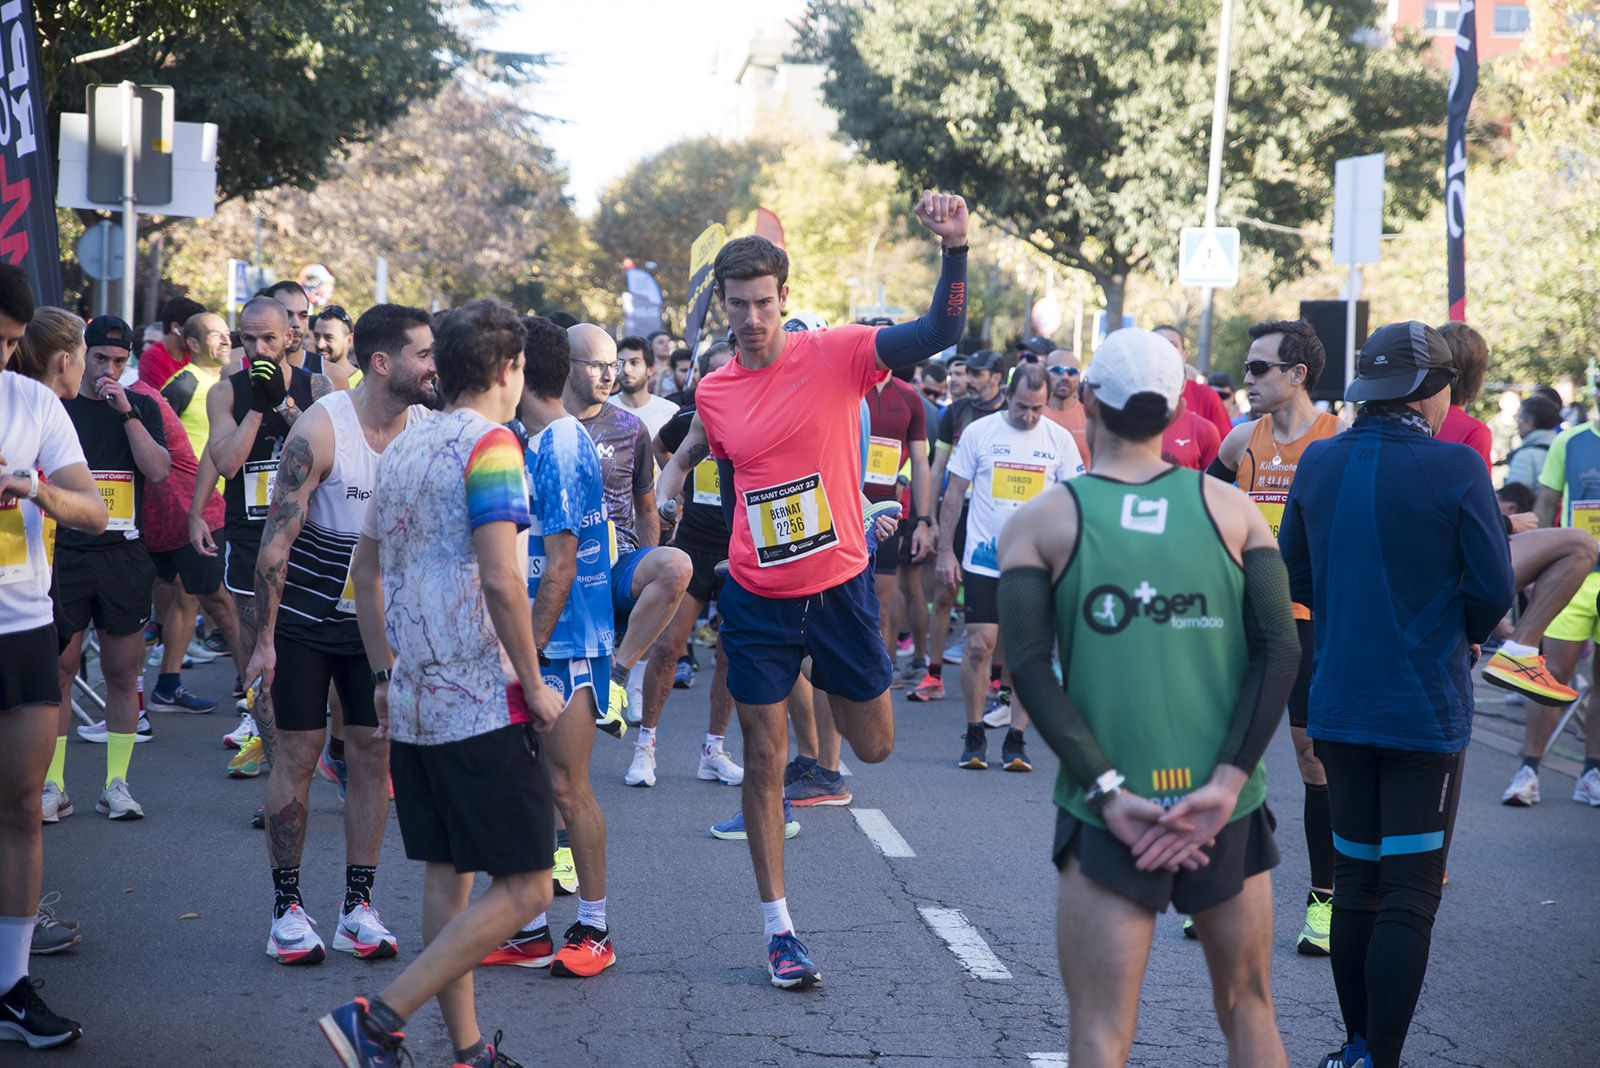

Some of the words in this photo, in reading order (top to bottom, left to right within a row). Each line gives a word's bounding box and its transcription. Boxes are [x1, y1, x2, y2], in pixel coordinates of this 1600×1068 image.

[1033, 450, 1055, 460] 2XU
[760, 491, 779, 500] SANT
[779, 484, 805, 496] CUGAT
[805, 480, 815, 488] 22
[1265, 494, 1281, 502] SANT
[770, 502, 801, 520] BERNAT
[776, 517, 805, 537] 2256
